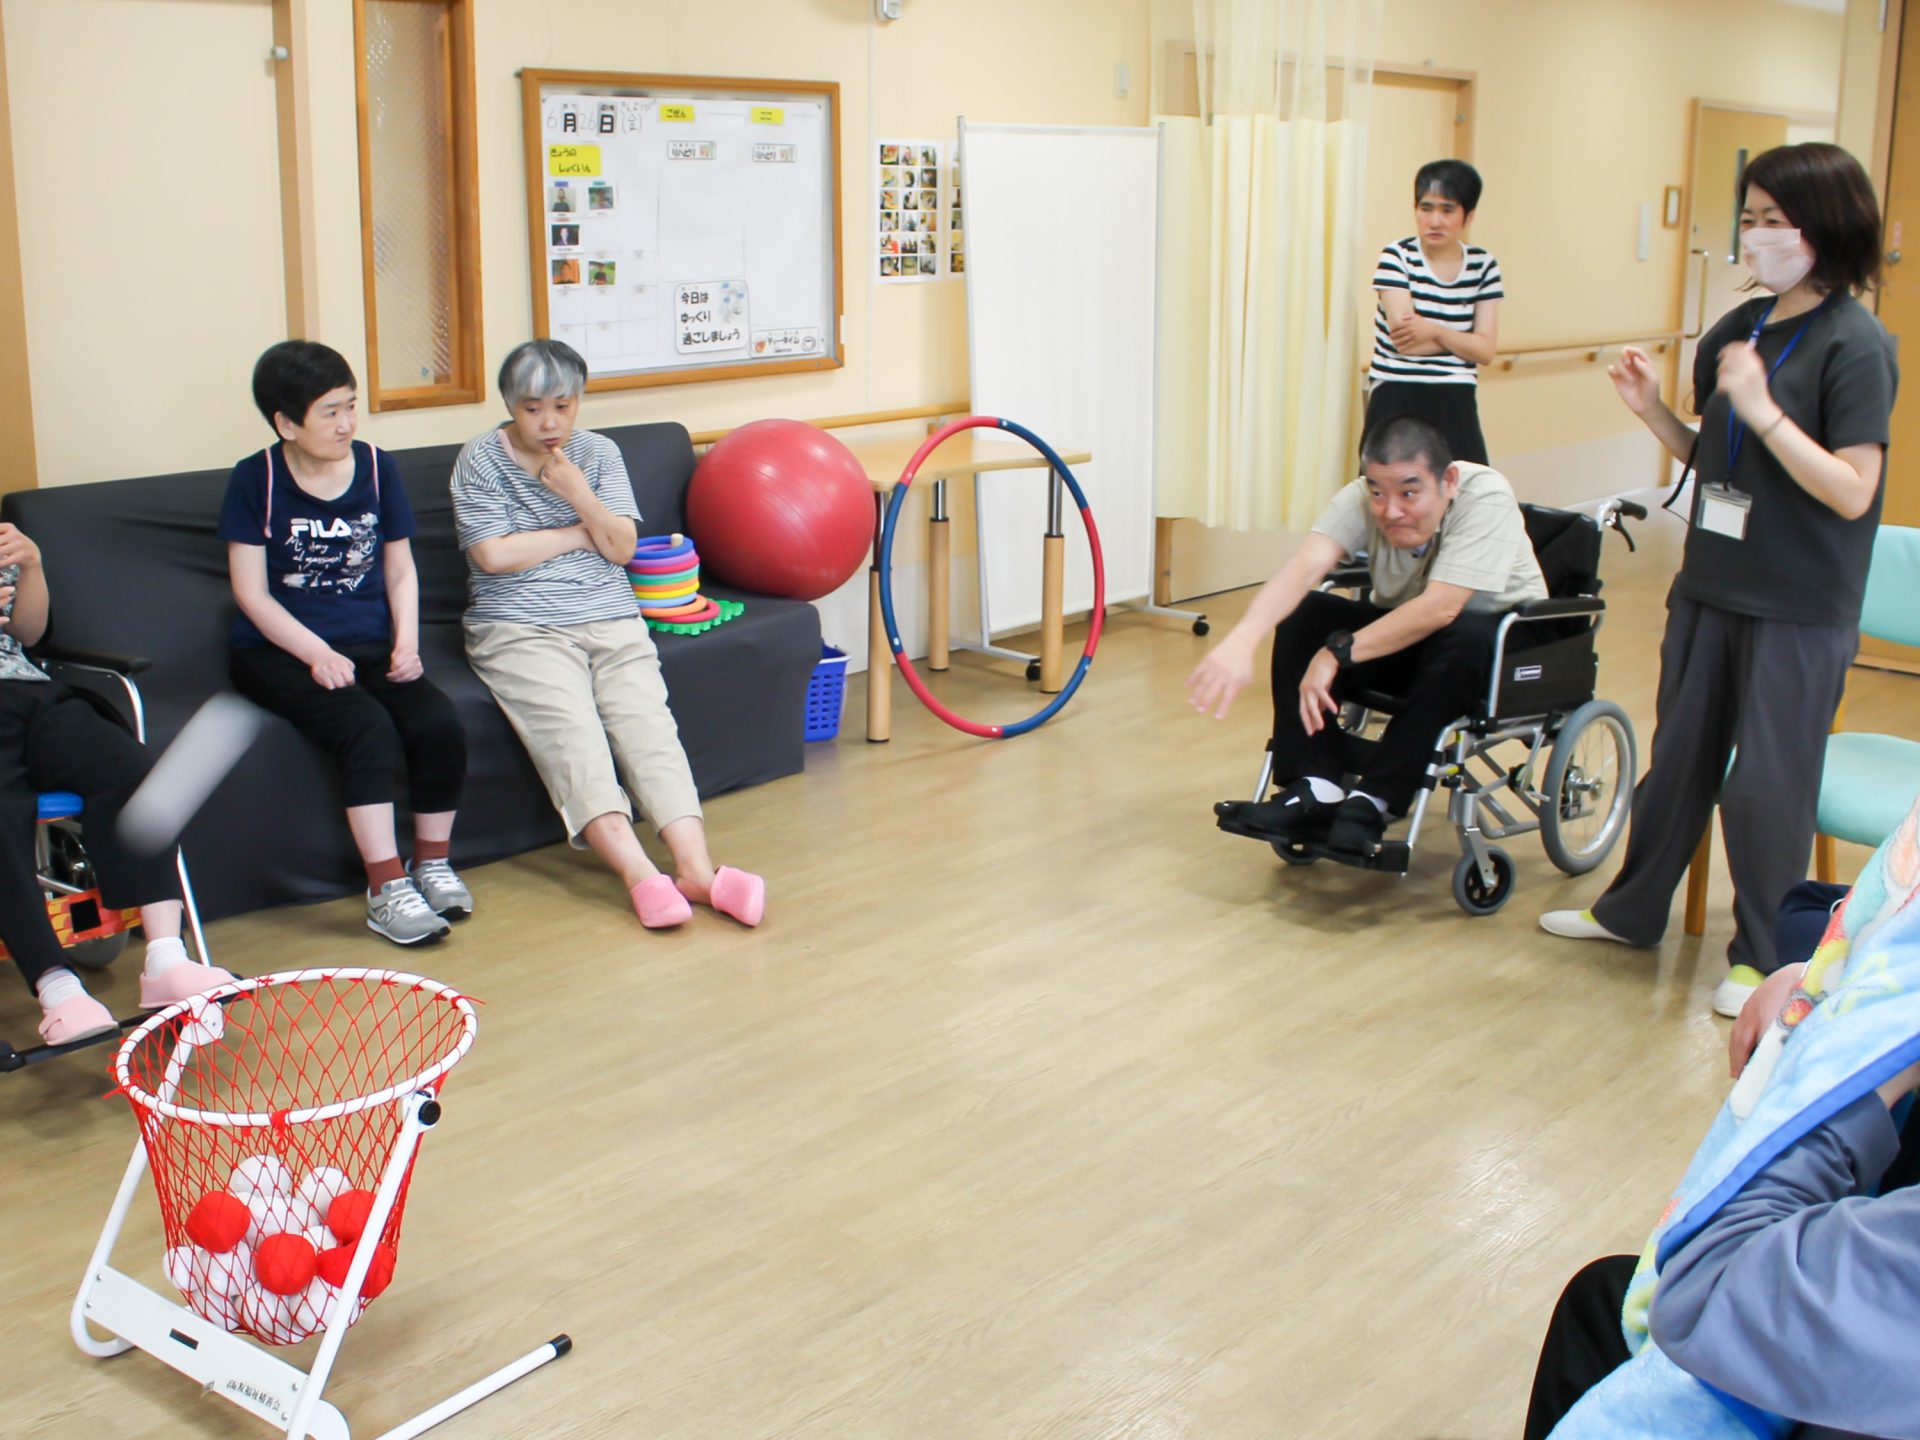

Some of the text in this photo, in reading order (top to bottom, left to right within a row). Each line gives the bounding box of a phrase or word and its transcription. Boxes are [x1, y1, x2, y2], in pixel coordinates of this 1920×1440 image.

[681, 291, 709, 304] 今日は
[680, 309, 711, 323] ゆっくり
[682, 328, 741, 346] 過ごしましょう
[290, 517, 353, 538] FILA
